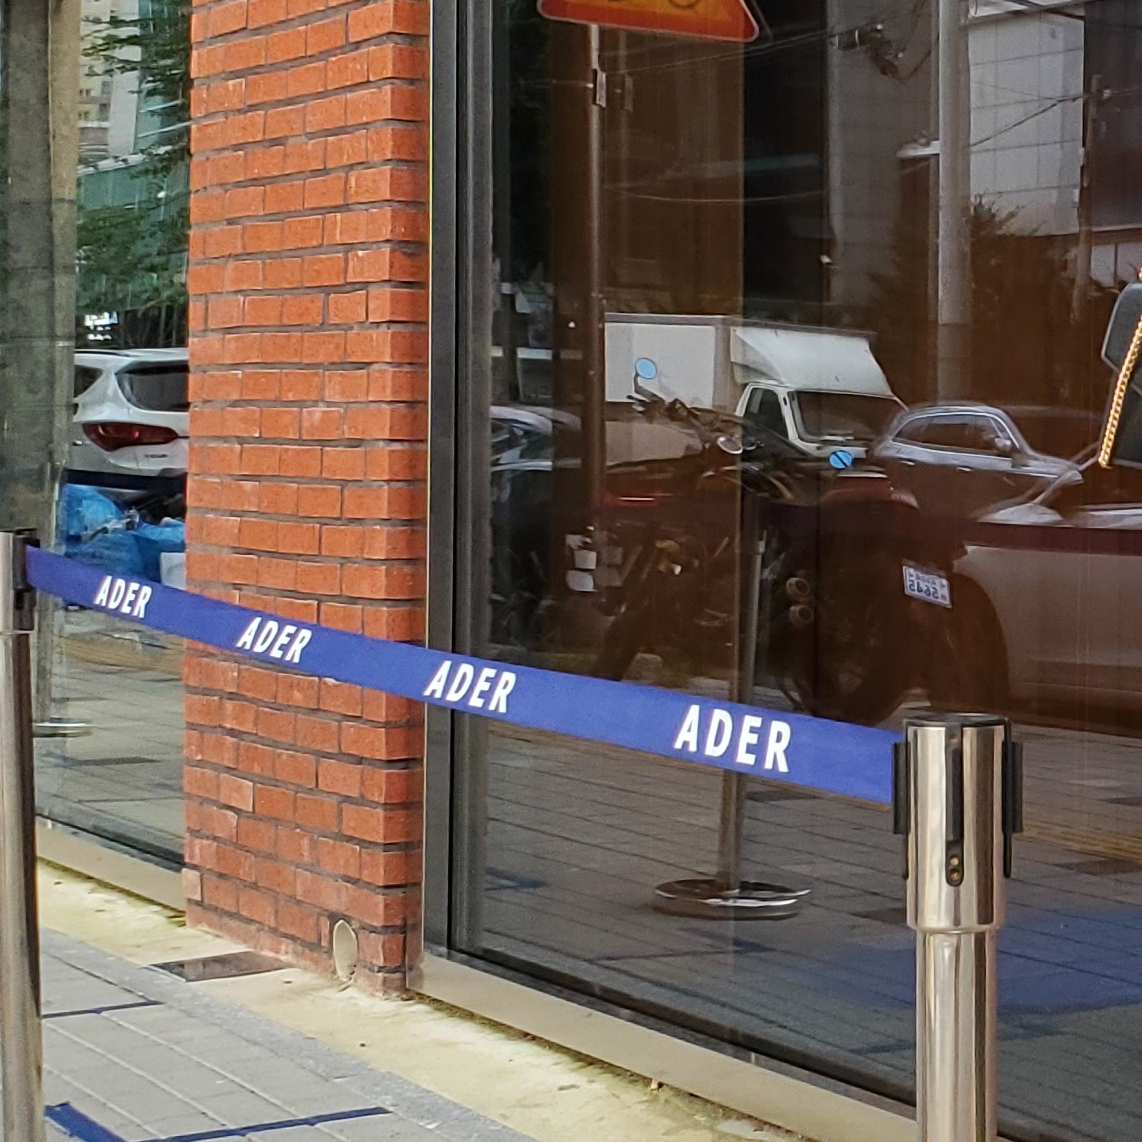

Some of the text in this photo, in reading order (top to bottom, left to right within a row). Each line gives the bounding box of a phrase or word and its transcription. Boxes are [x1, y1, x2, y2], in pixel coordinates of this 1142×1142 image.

[93, 575, 152, 619] ADER
[235, 616, 313, 664] ADER
[422, 660, 517, 714] ADER
[673, 704, 791, 773] ADER
